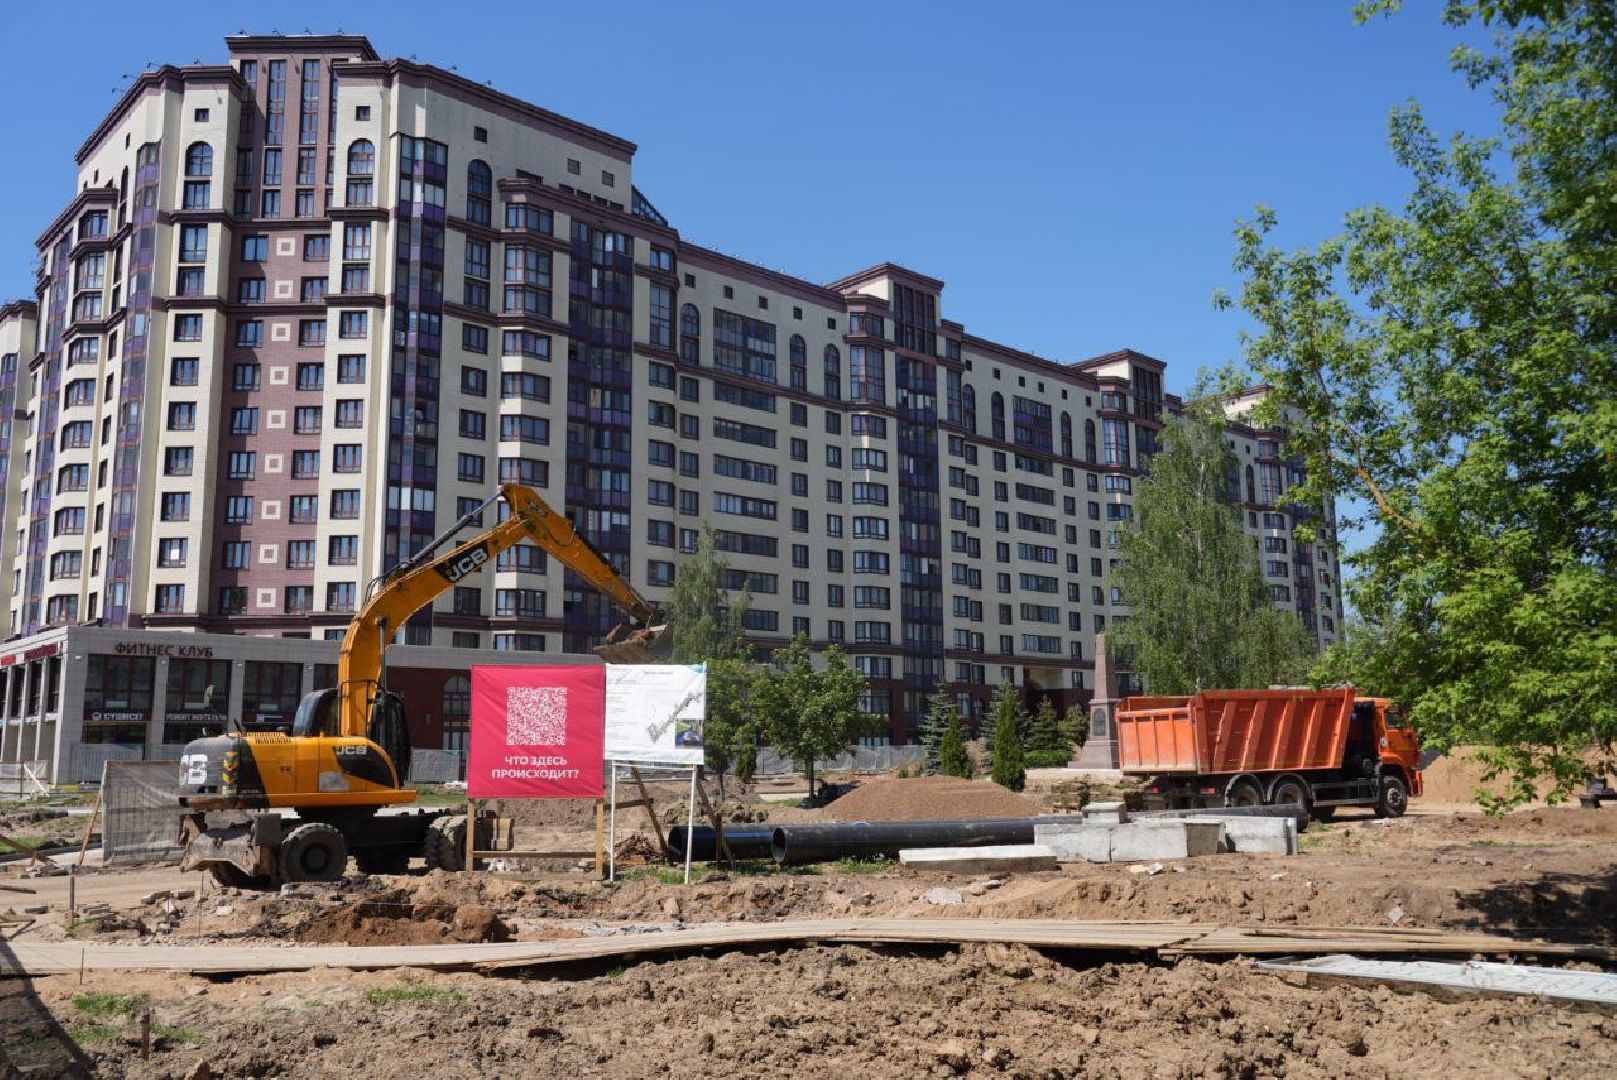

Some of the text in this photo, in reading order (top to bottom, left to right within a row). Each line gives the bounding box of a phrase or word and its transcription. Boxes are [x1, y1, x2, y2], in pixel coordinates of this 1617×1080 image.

[448, 549, 488, 581] JCB
[114, 642, 213, 657] ФИТНЕС КЛУБ
[335, 745, 367, 755] JCB
[504, 756, 568, 767] ЧТО ЗДЕСЬ
[491, 769, 580, 780] ПРОИСХОДИТ?
